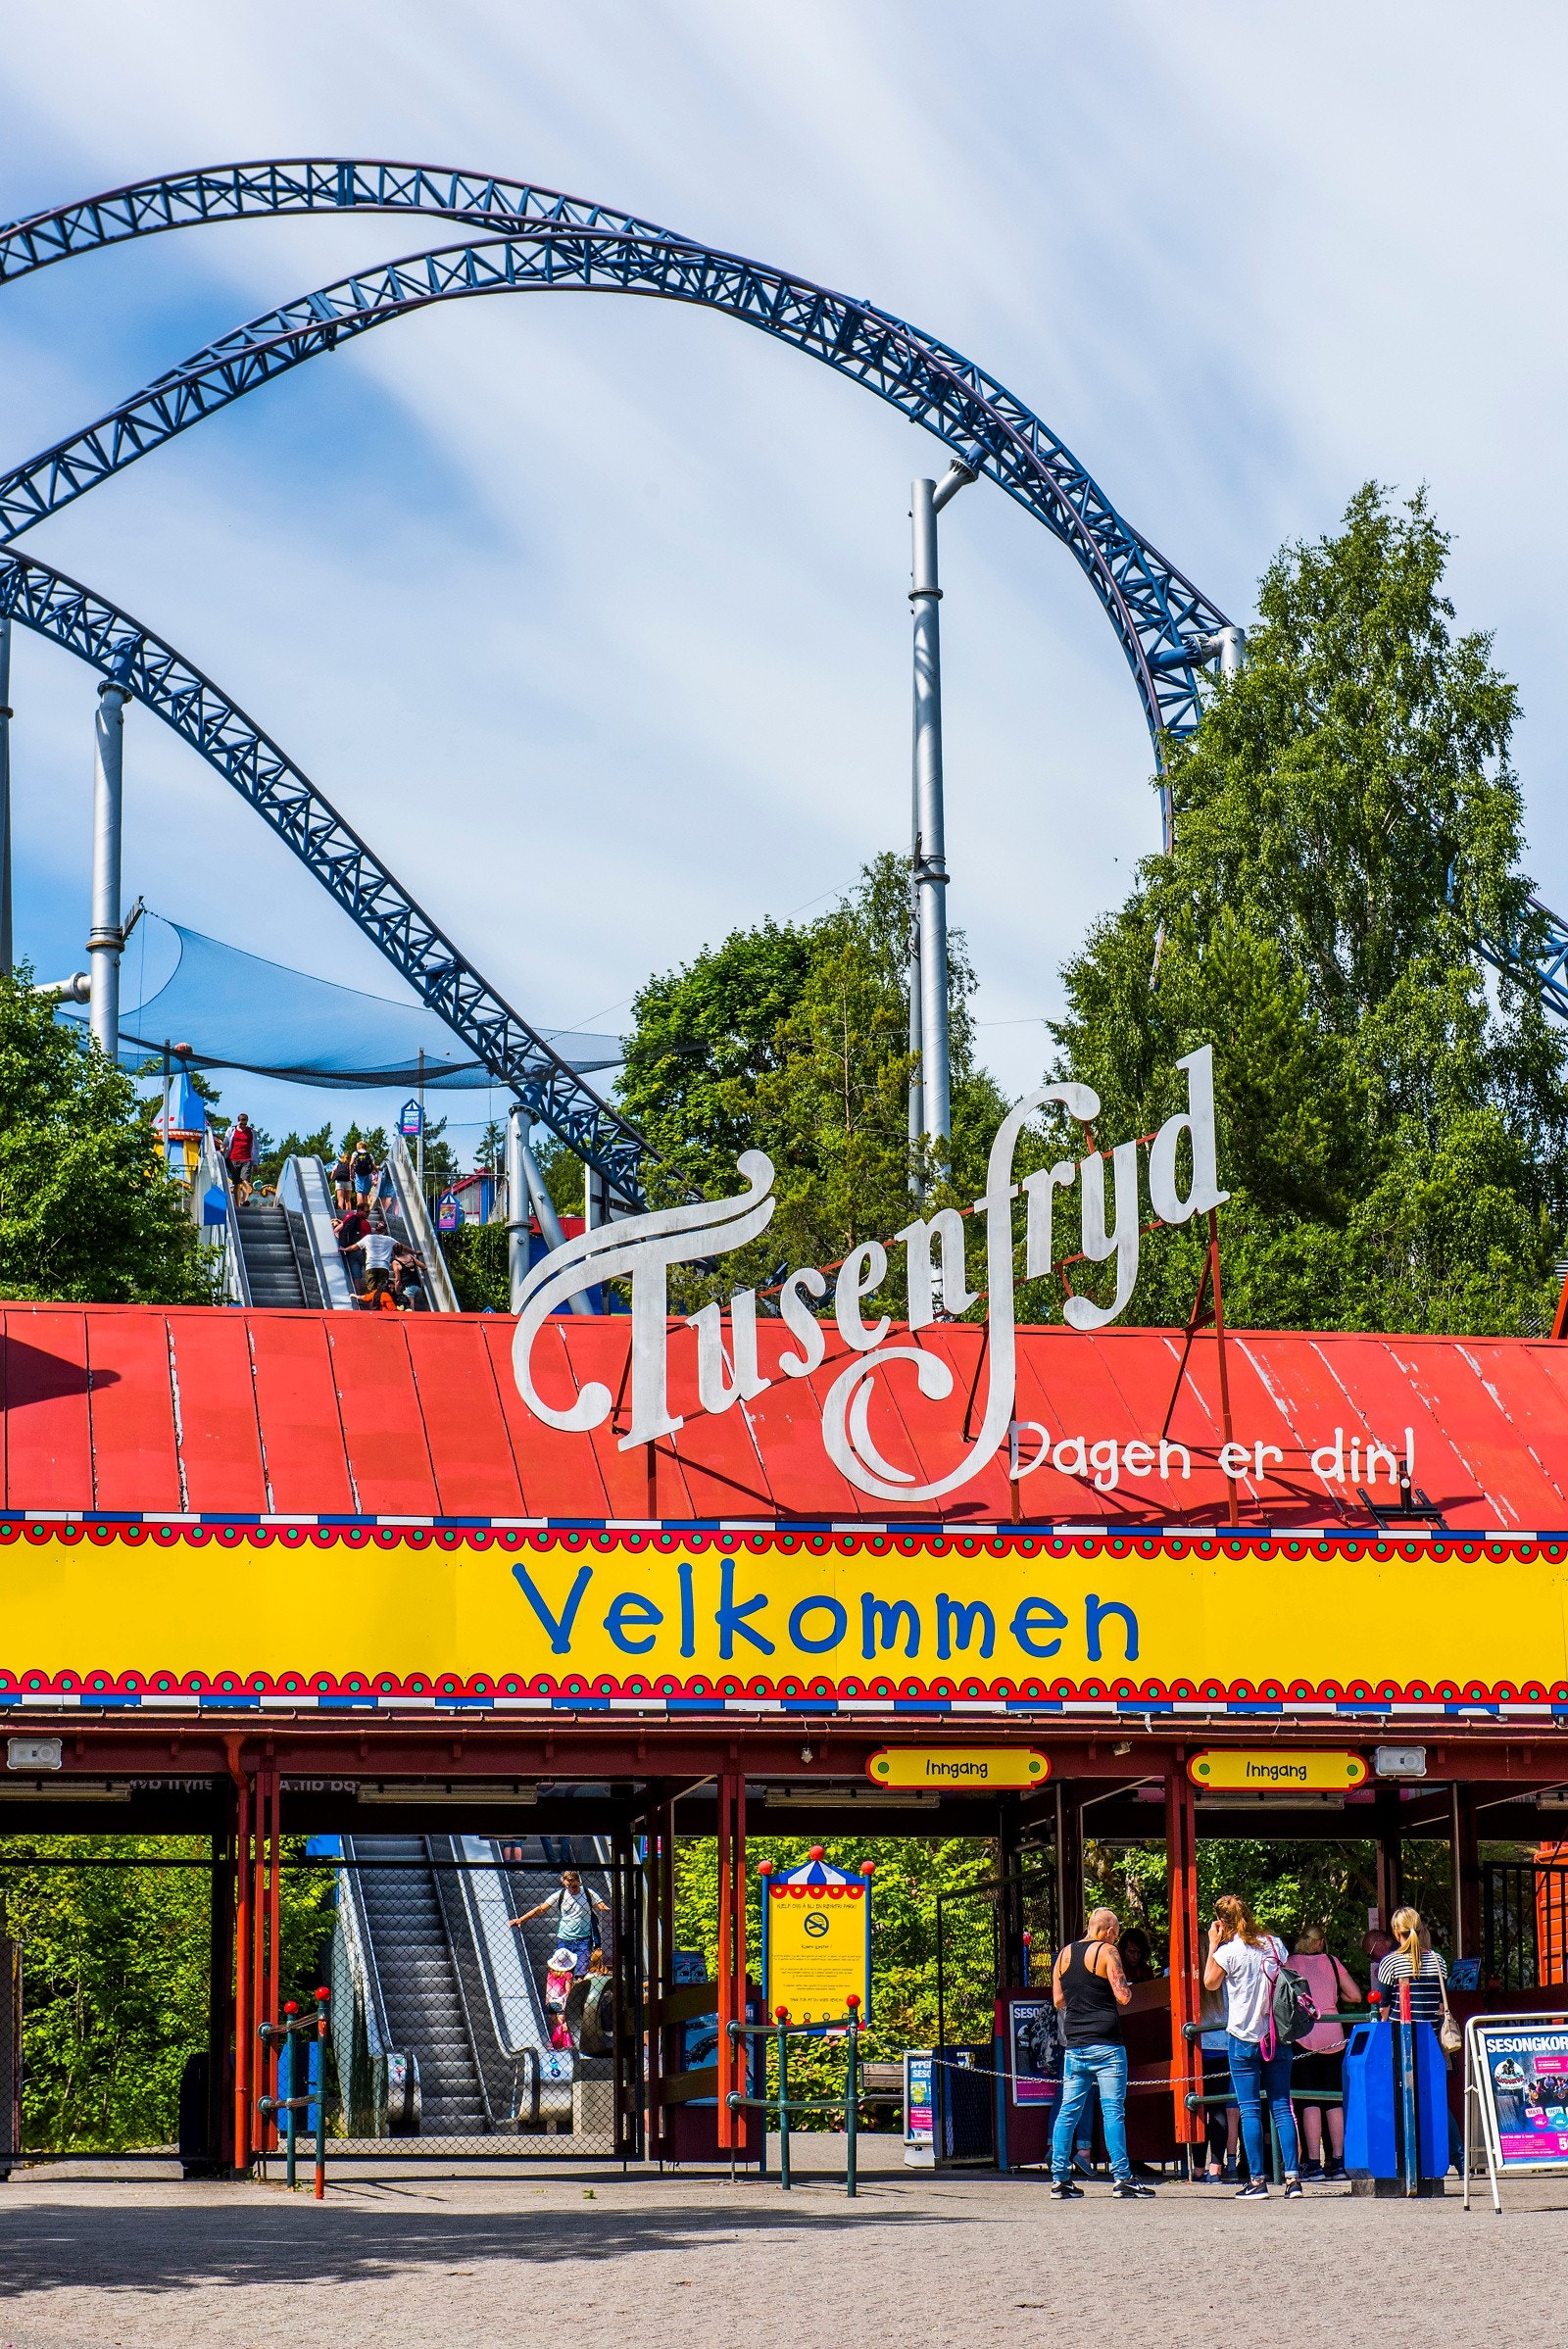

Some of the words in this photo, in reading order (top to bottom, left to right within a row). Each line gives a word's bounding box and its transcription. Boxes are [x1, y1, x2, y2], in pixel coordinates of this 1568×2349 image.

[512, 1044, 1231, 1502] Tusenfryd
[1008, 1420, 1192, 1492] Dagen
[1218, 1440, 1284, 1482] er
[1310, 1427, 1415, 1489] din!
[511, 1558, 1140, 1661] Velkommen
[924, 1758, 989, 1779] Inngang
[1246, 1761, 1308, 1782] Inngang
